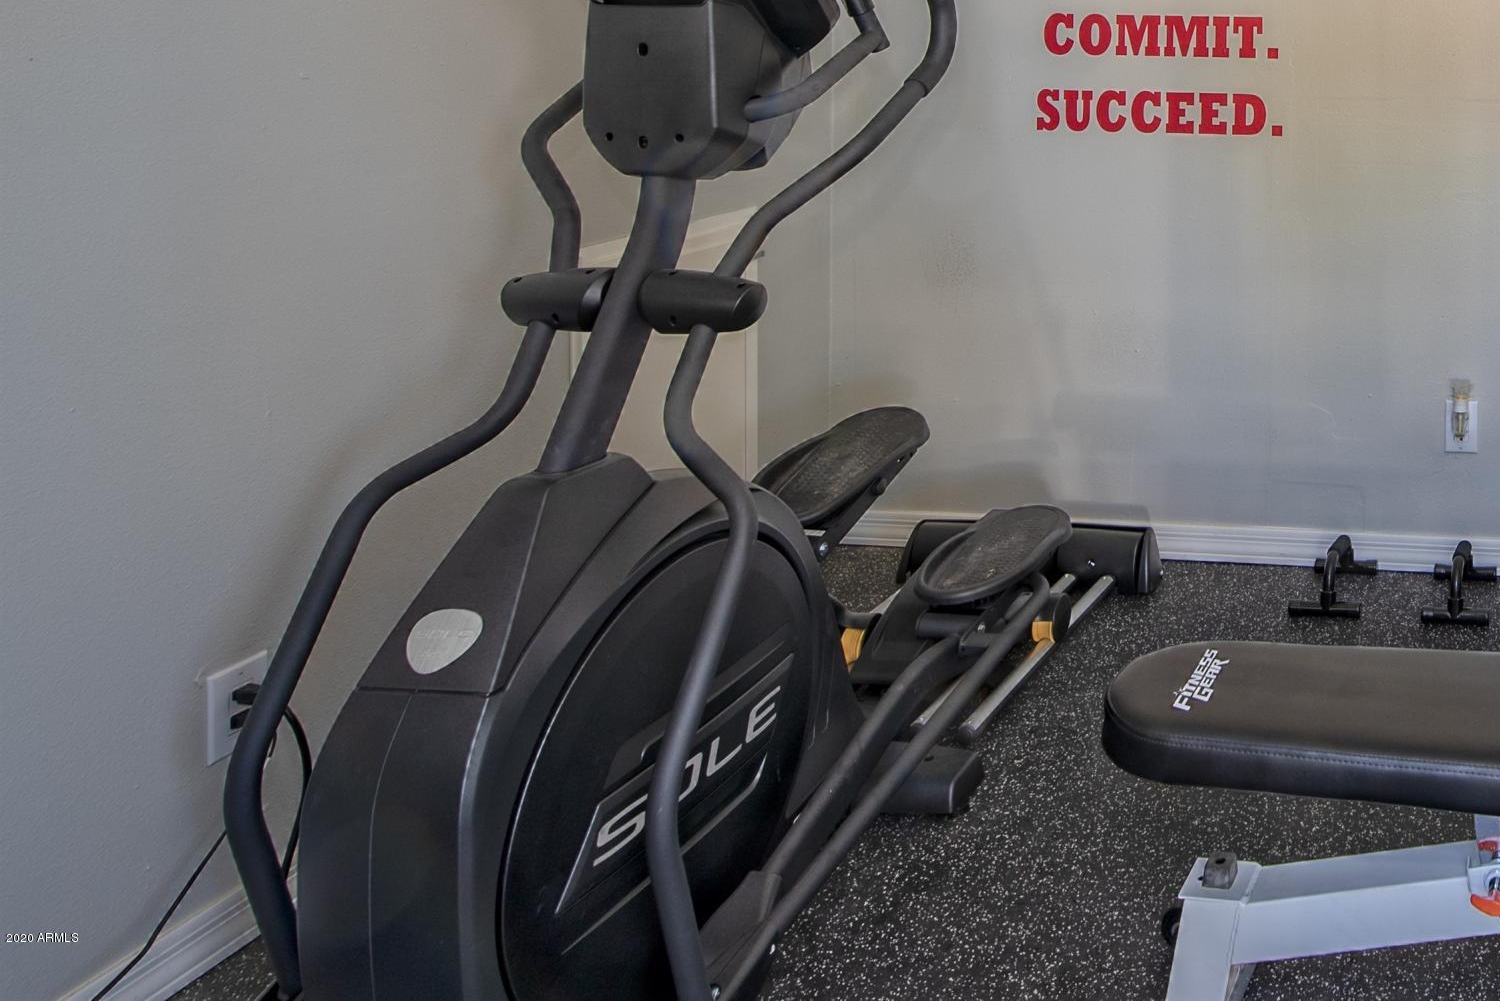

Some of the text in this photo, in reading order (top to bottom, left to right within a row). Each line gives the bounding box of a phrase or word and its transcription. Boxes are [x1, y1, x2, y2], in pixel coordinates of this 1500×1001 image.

[1043, 12, 1279, 59] COMMIT.
[1036, 88, 1283, 137] SUCCEED.
[1173, 649, 1218, 711] FITNESS
[1192, 659, 1230, 702] GEAR
